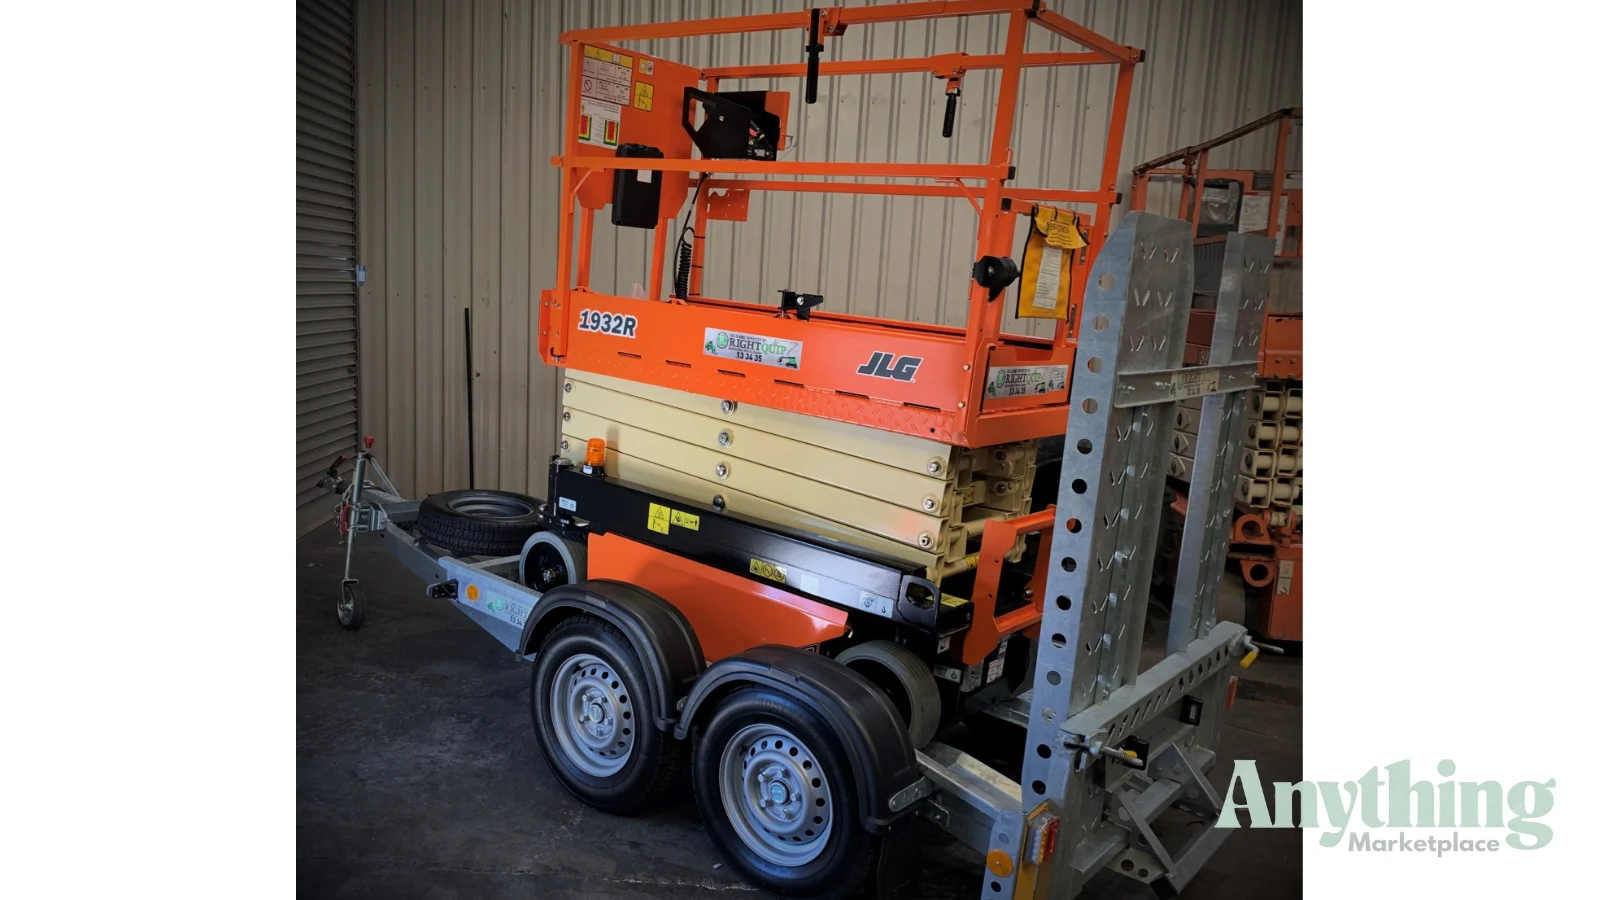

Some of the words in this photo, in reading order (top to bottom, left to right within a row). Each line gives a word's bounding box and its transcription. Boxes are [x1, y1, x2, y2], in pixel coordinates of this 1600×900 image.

[579, 310, 637, 337] 1932R
[729, 338, 787, 354] RIGHTQUIP
[745, 353, 753, 361] 34
[856, 351, 923, 382] JLG
